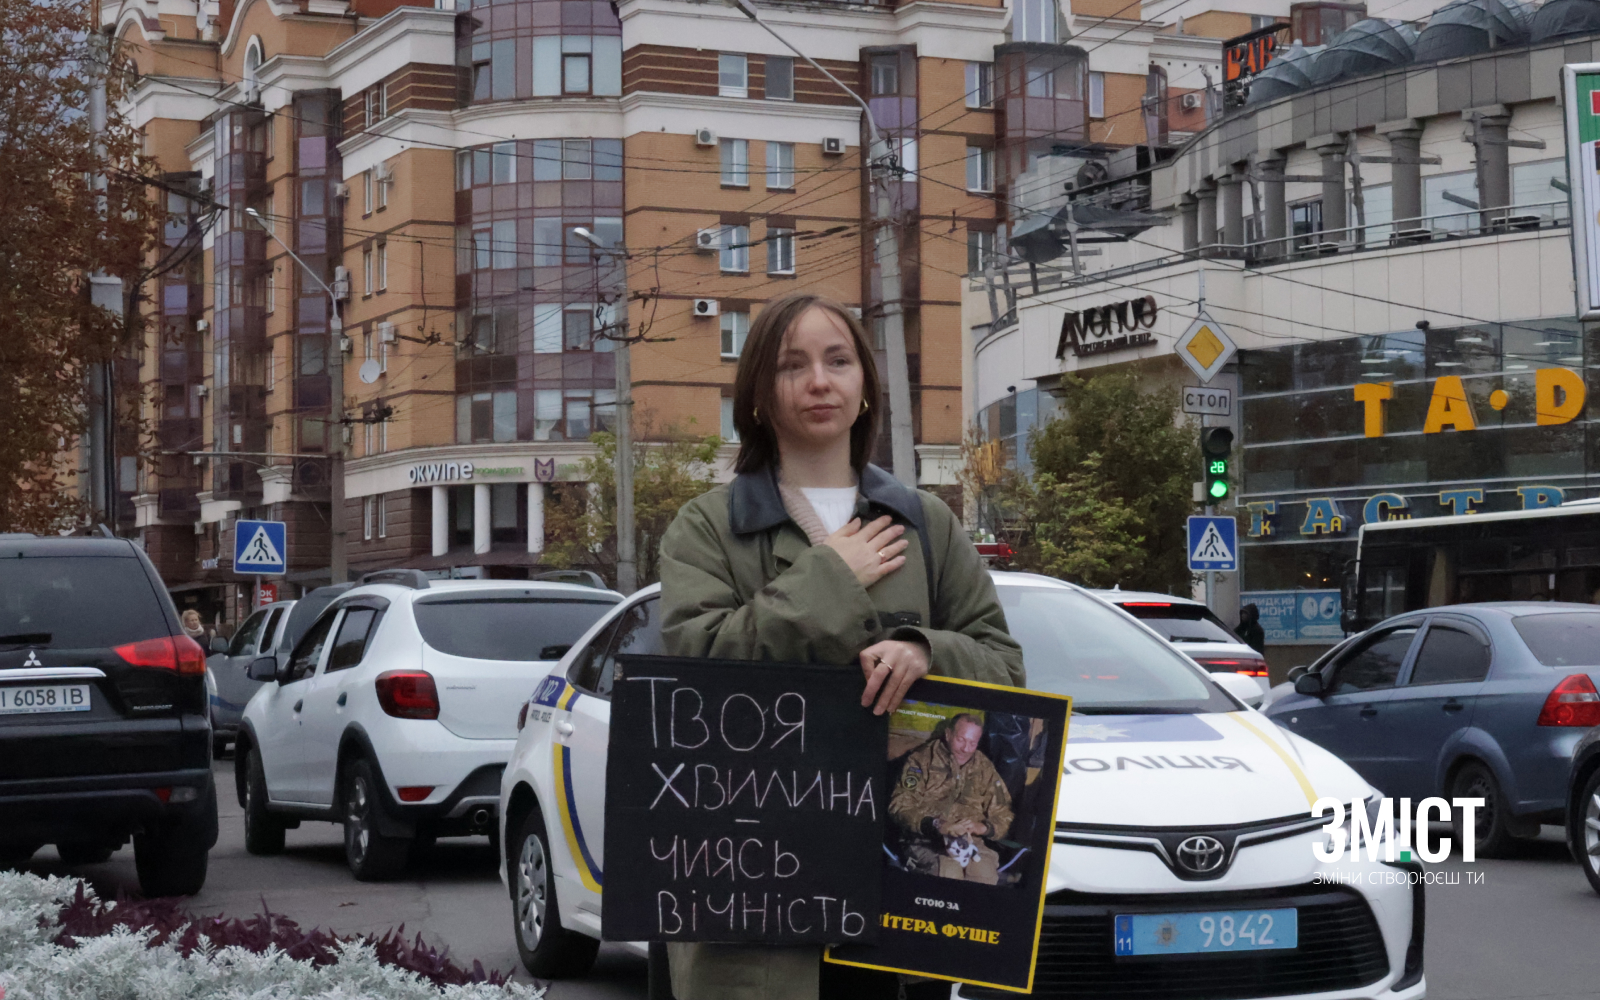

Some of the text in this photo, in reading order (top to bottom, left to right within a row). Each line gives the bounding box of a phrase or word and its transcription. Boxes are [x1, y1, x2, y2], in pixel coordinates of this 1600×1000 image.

[1185, 393, 1228, 408] СТОП
[1210, 461, 1225, 473] 28
[1259, 606, 1295, 616] МОНТ
[1264, 629, 1296, 638] РОКС
[14, 688, 57, 706] 6058
[63, 688, 84, 705] IB
[626, 677, 805, 753] ТВОЯ
[650, 763, 876, 820] ХВИЛИНА
[650, 835, 799, 881] ЧИЯСЬ
[915, 896, 960, 911] СТОЮ ЗА
[880, 912, 1000, 945] ІТЕРА ФУШЕ
[1118, 914, 1274, 951] 11 9842
